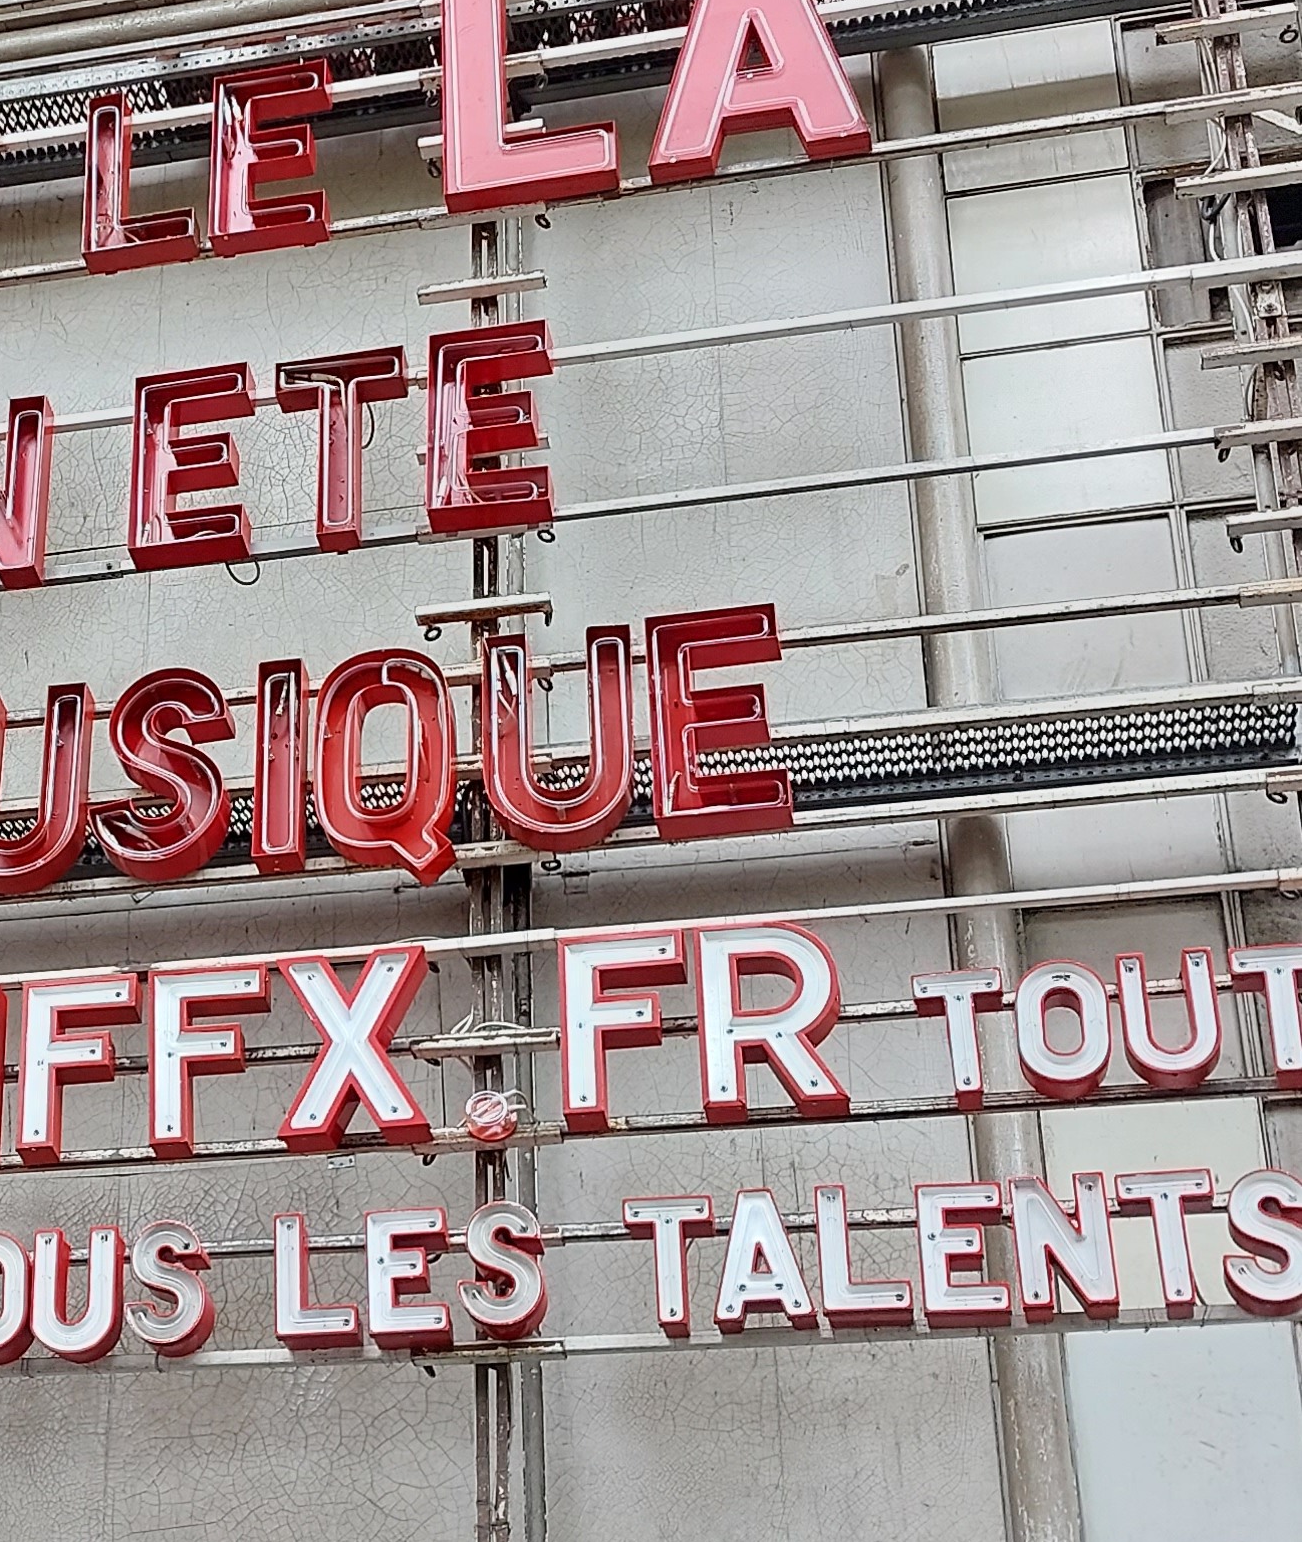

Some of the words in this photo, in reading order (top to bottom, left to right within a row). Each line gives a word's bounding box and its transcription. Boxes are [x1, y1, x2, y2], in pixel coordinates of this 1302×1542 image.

[82, 58, 333, 276] LE
[128, 319, 556, 571] ETE
[910, 943, 1302, 1112] TOUT
[273, 1200, 548, 1353] LES
[621, 1167, 1302, 1338] TALENTS
